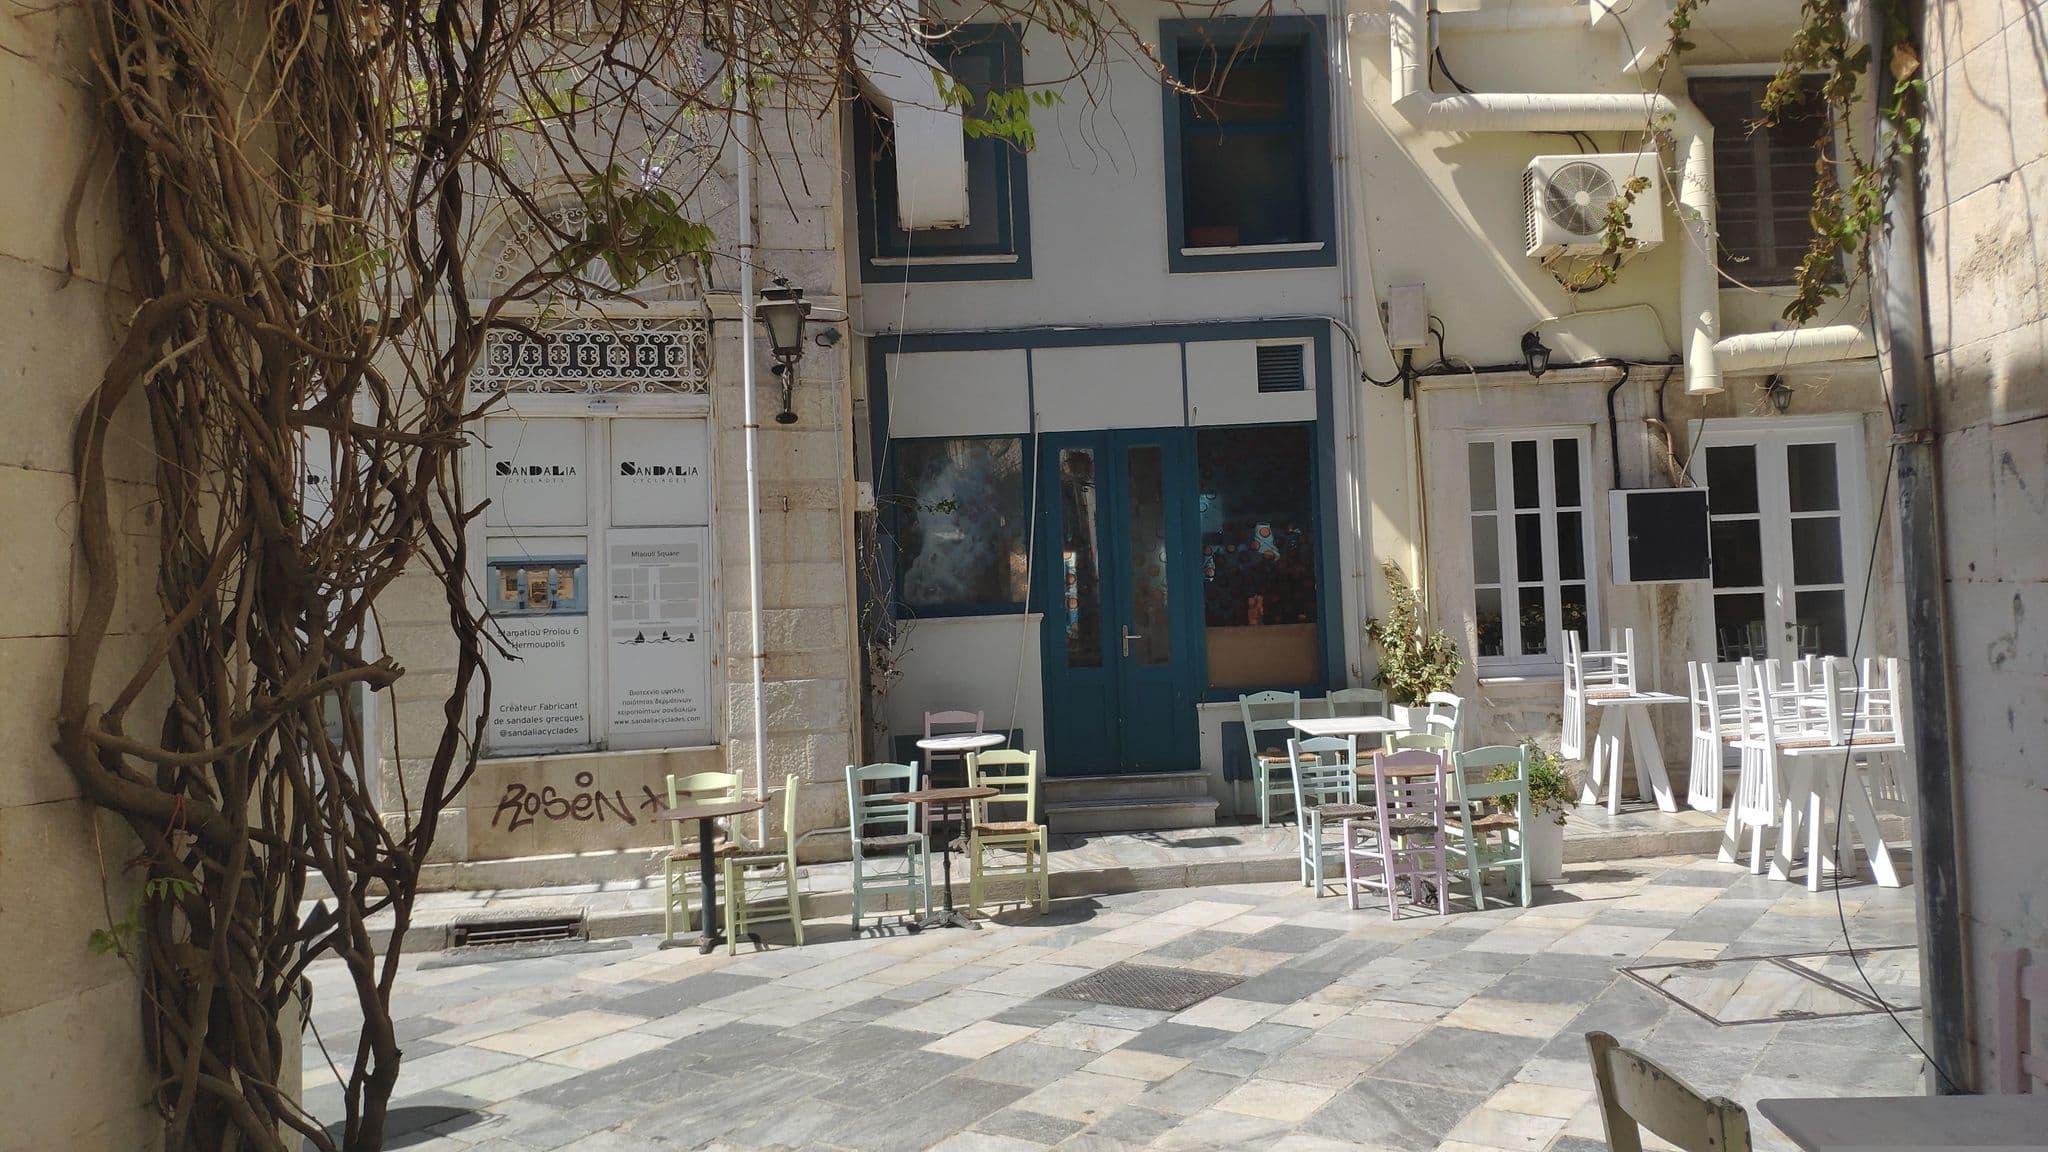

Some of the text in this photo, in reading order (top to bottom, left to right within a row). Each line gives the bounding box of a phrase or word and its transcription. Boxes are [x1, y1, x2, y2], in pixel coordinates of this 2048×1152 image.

[495, 461, 577, 476] SANDALIA
[620, 461, 699, 476] SANDALIA
[656, 550, 680, 559] Square
[573, 627, 580, 635] 6
[511, 640, 566, 649] Hermoupolis
[499, 701, 578, 713] Créateur Fabricant
[493, 714, 585, 725] de sandales grecques
[499, 726, 579, 738] @sandaliacyclades
